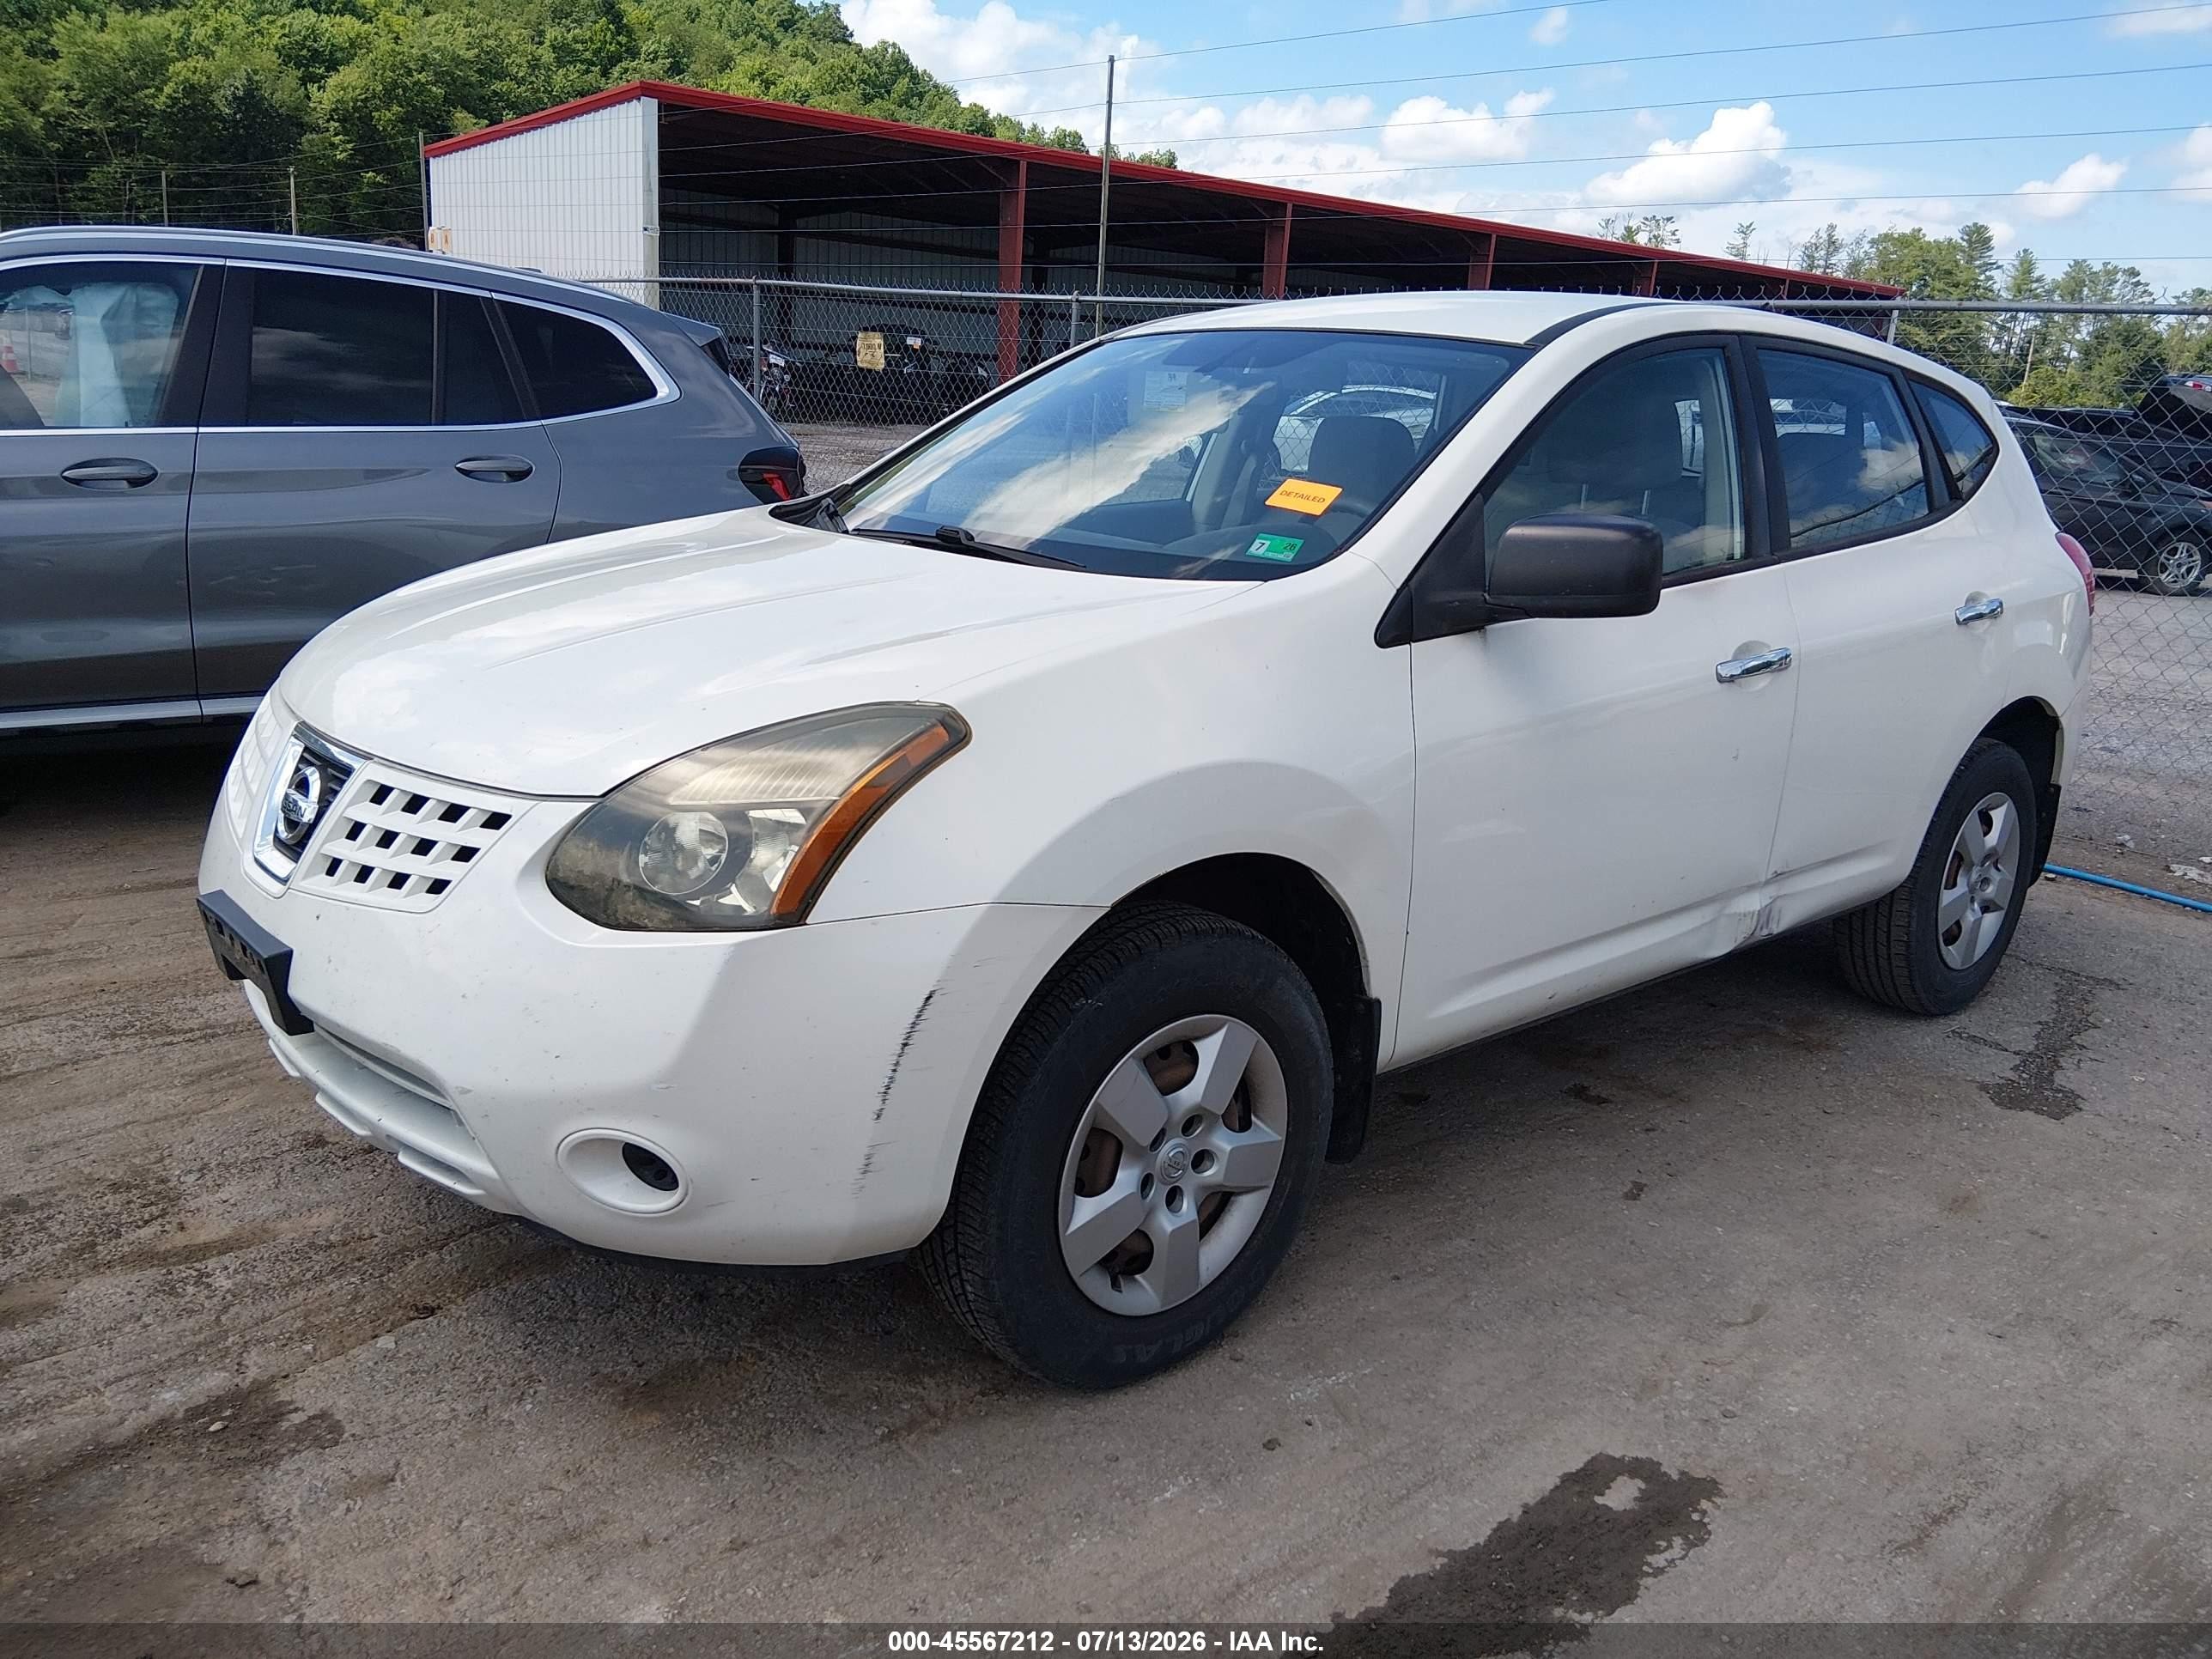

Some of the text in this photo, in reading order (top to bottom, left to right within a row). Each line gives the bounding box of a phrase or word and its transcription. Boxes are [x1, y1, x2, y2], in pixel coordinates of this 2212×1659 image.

[1279, 489, 1326, 504] DETAILED
[1255, 542, 1297, 552] 7 26
